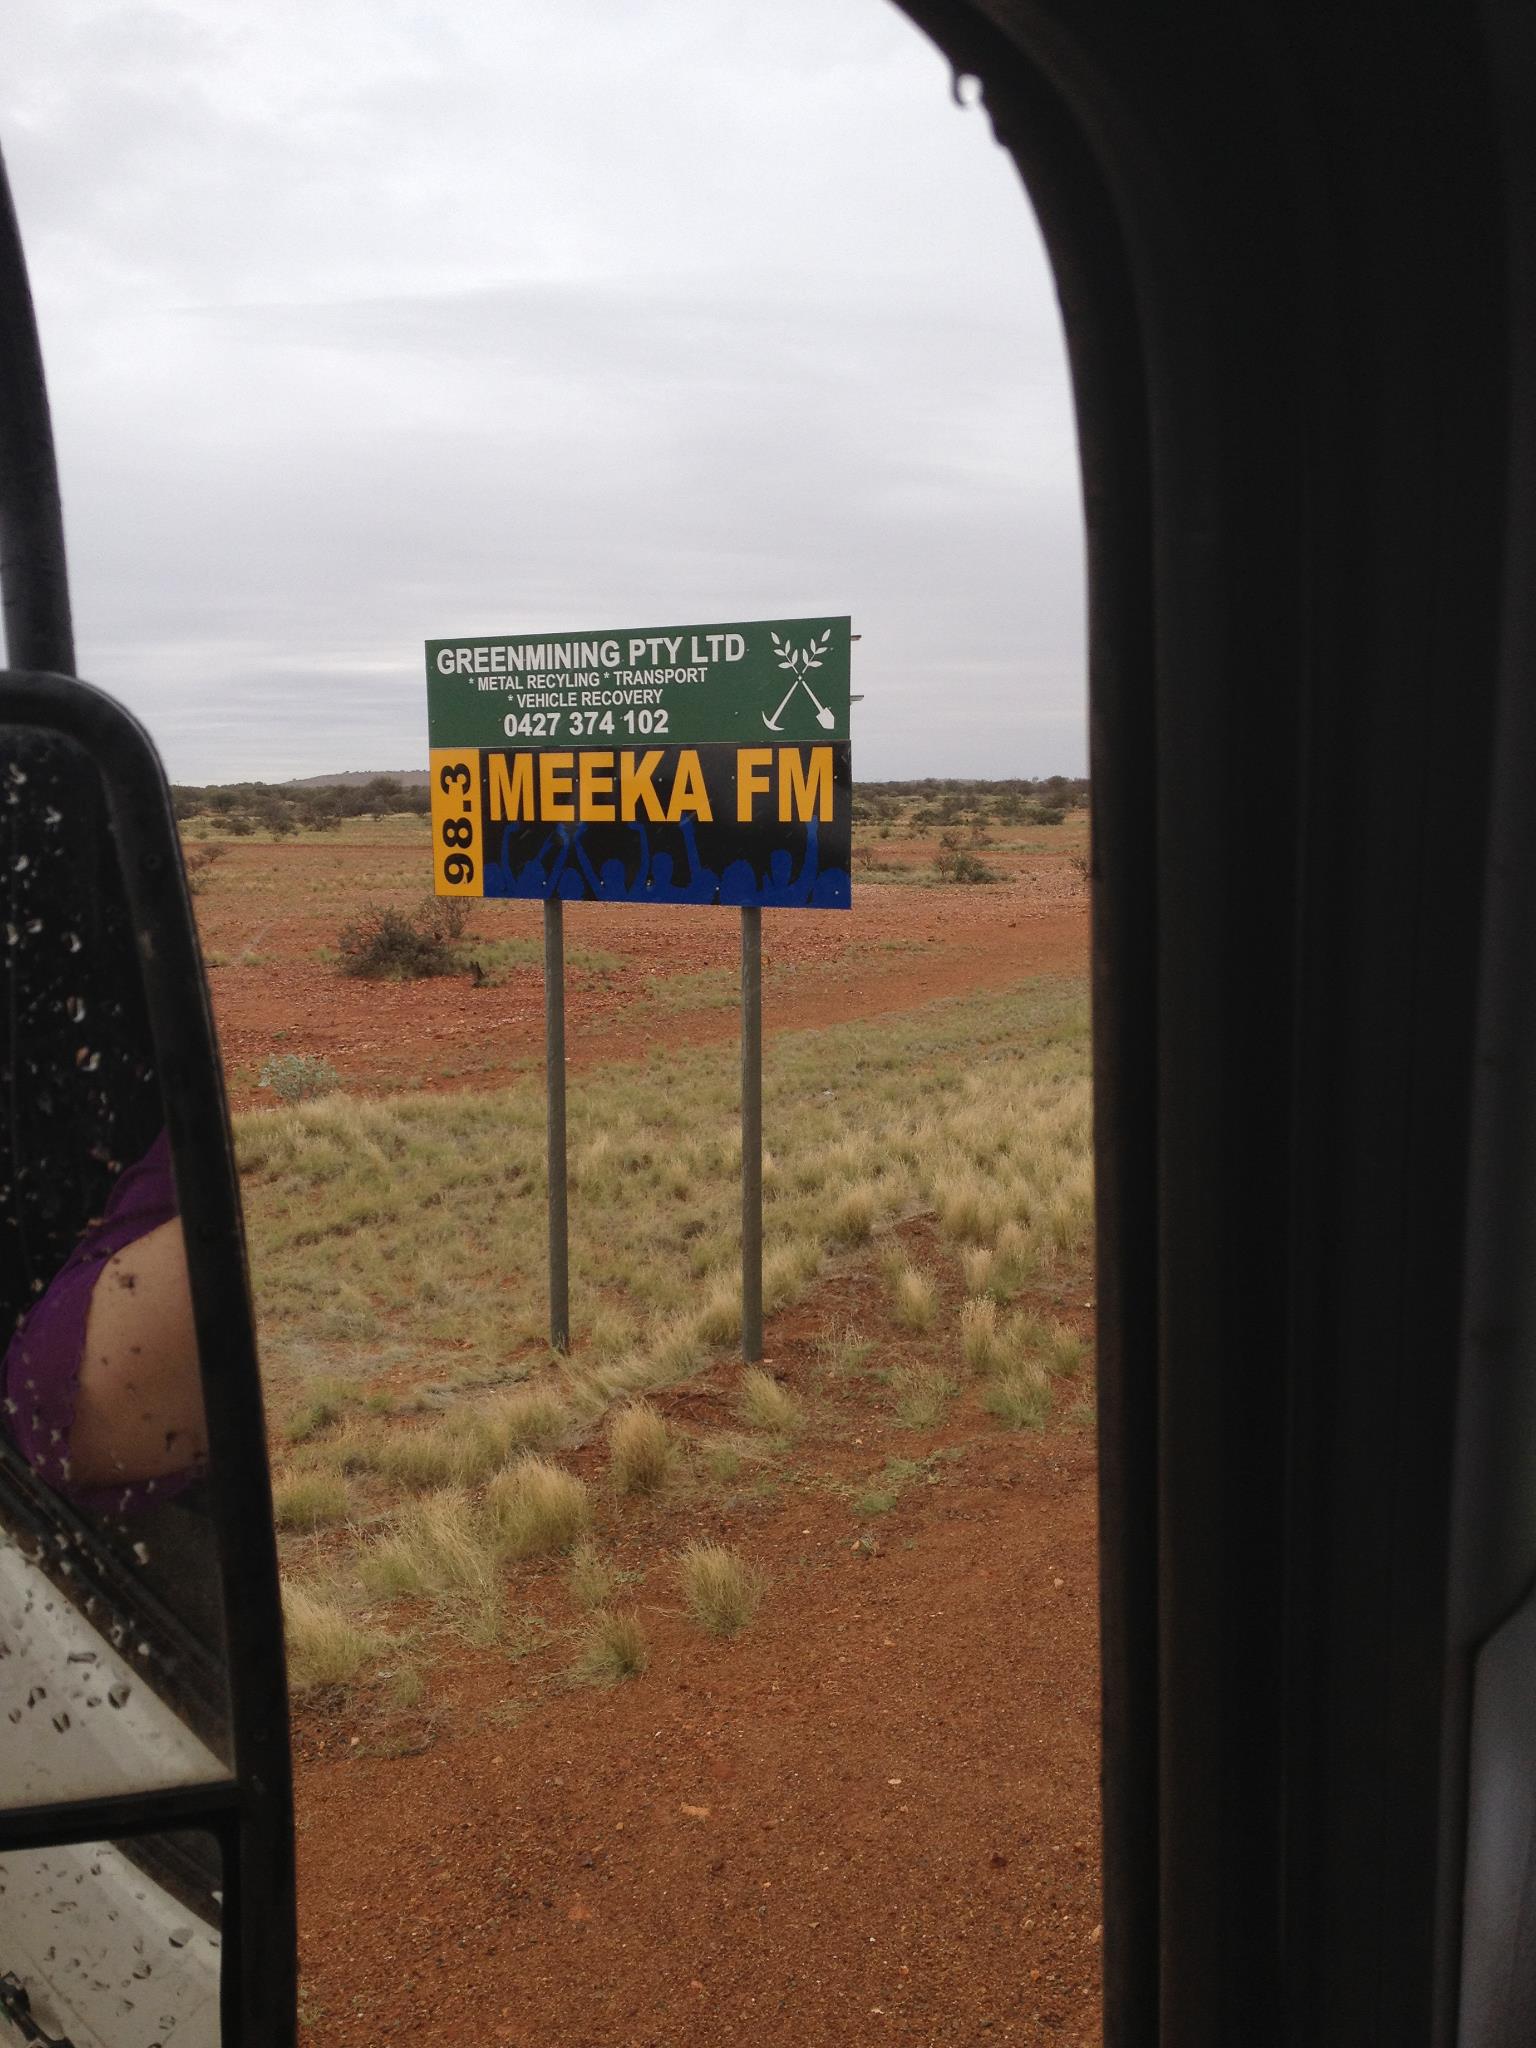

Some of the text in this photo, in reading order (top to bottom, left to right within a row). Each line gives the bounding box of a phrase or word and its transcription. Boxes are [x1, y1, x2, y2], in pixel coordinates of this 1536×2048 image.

[437, 634, 745, 675] GREENMINING PTY LTD
[478, 668, 707, 691] METAL RECYLING TRANSPORT
[517, 689, 663, 708] VEHICLE RECOVERY
[504, 709, 669, 737] 0427 374 102
[488, 746, 834, 822] MEEKA FM
[440, 763, 475, 885] 98.3
